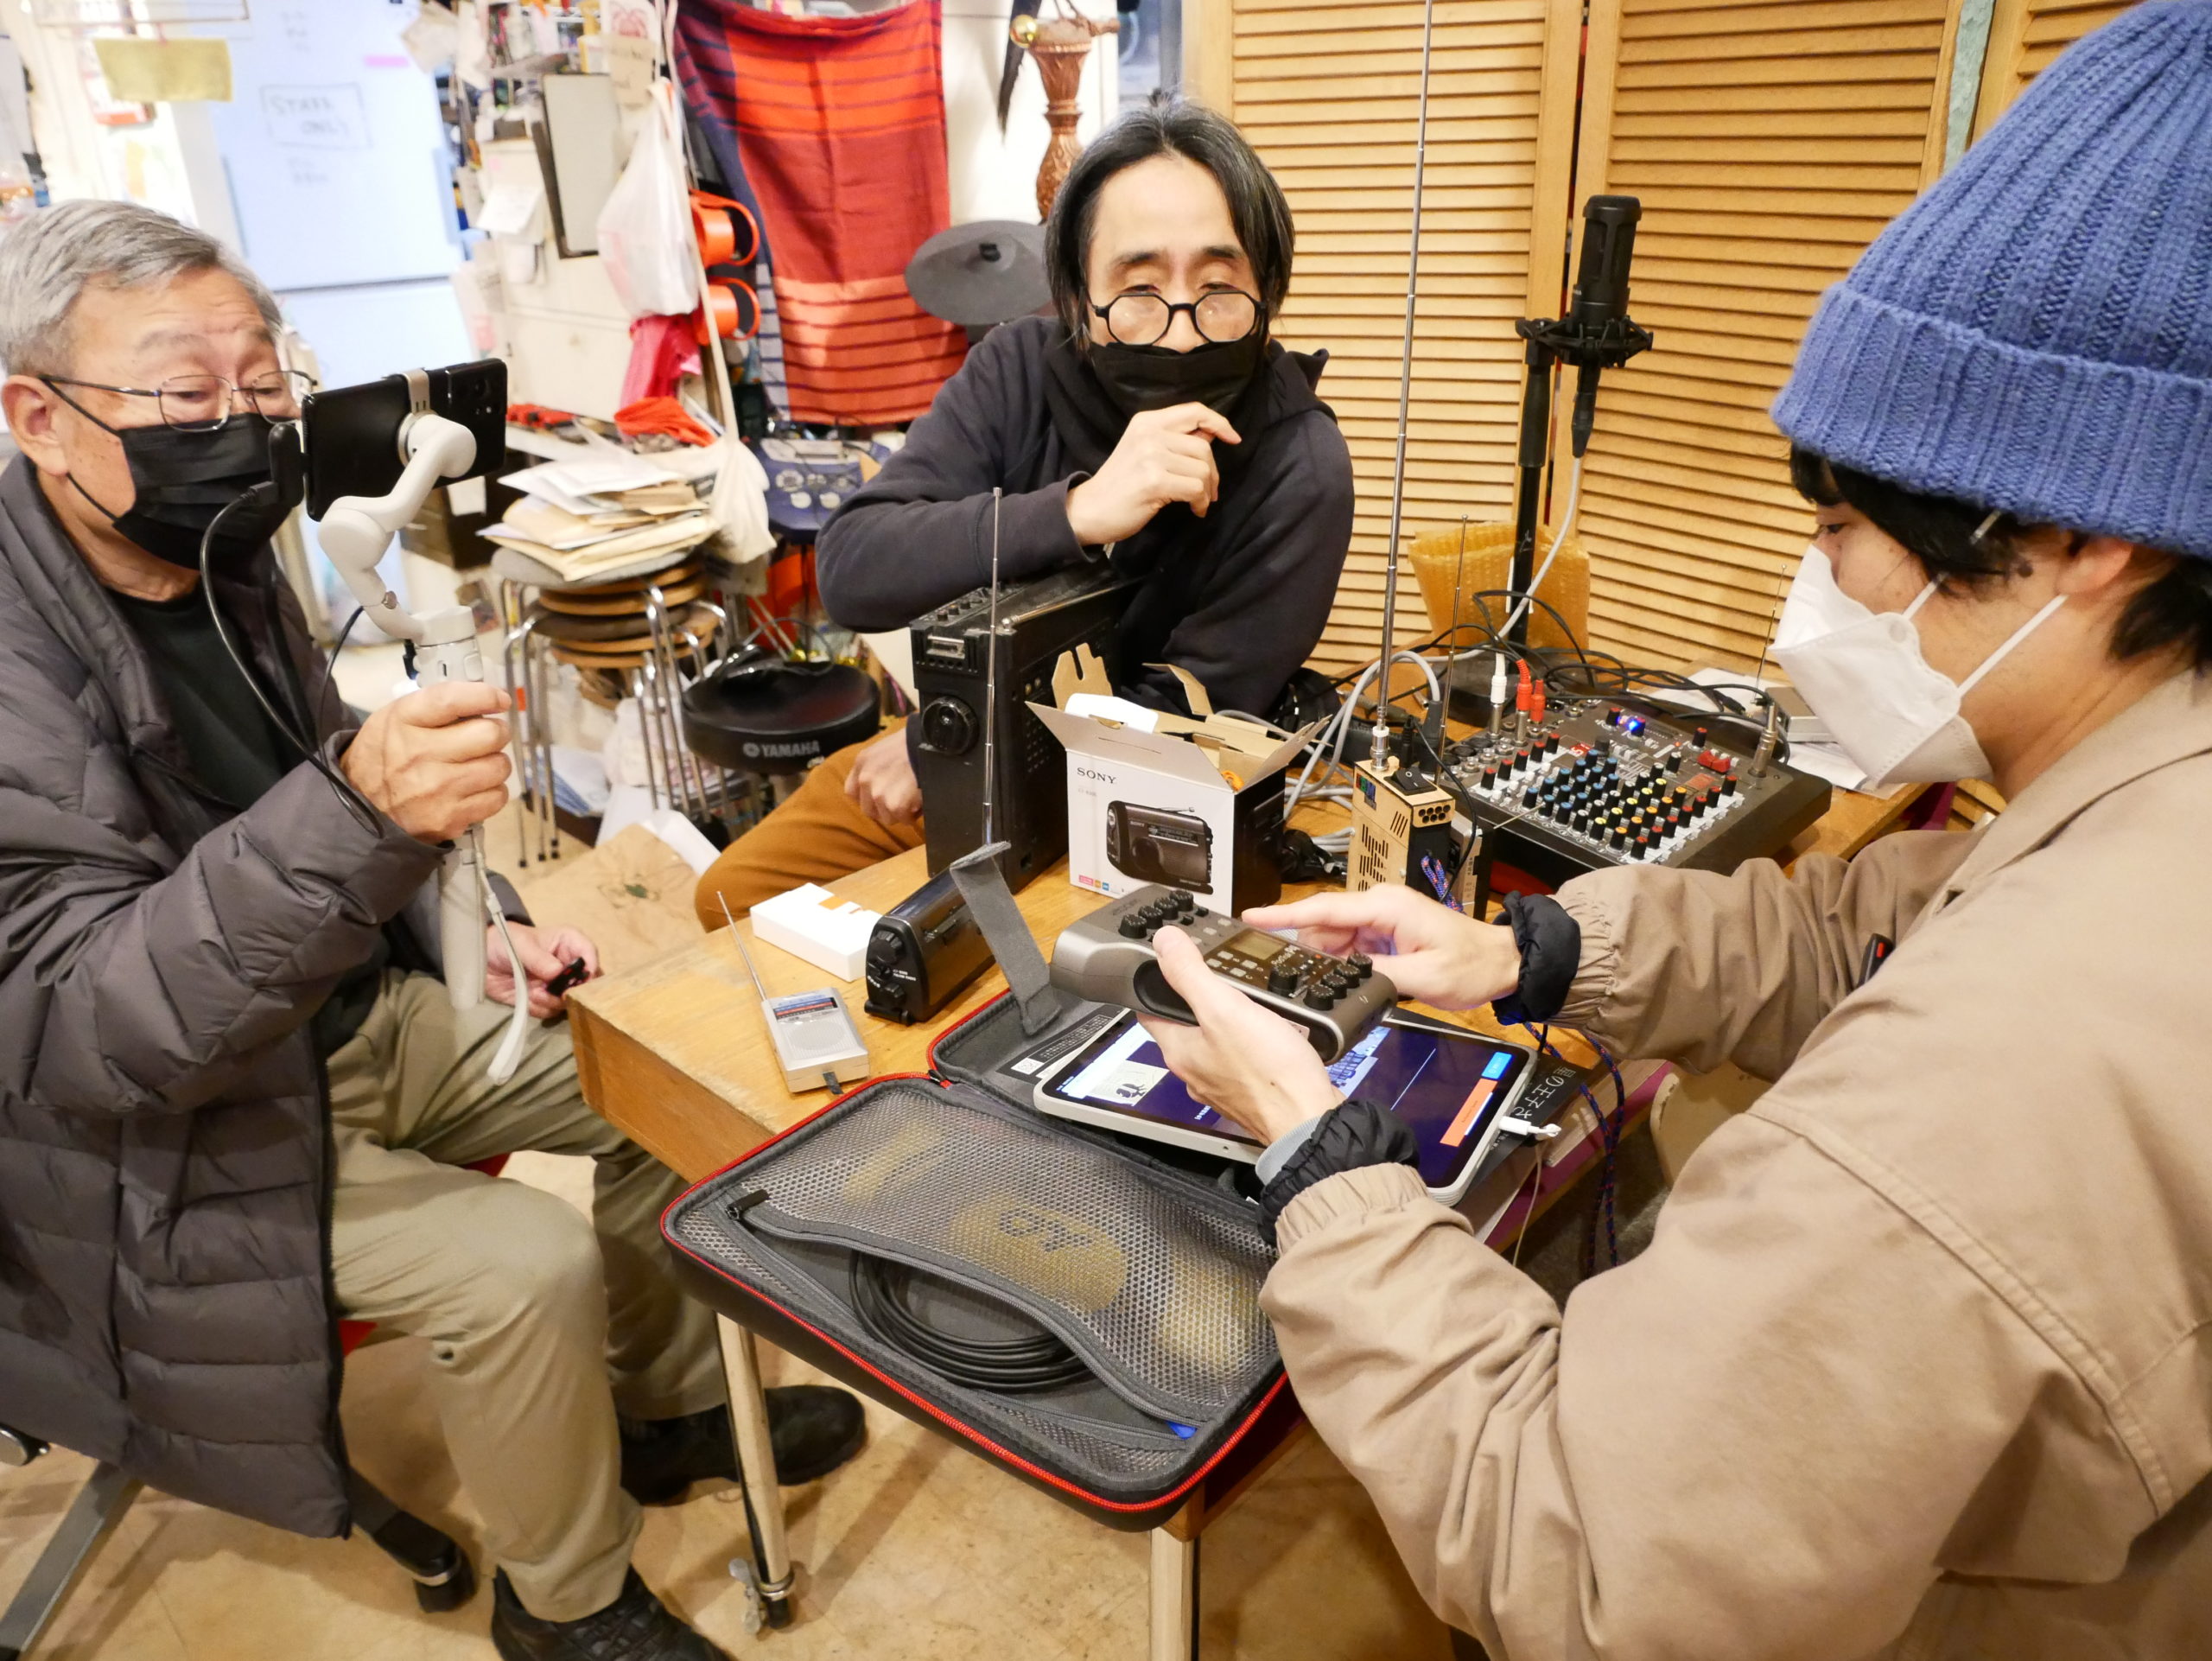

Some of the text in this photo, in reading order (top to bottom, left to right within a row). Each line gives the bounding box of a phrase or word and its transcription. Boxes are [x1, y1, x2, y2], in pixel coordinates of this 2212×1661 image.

[761, 741, 820, 757] YAMAHA
[1077, 767, 1117, 784] SONY
[1513, 1066, 1577, 1119] 星の王子さ
